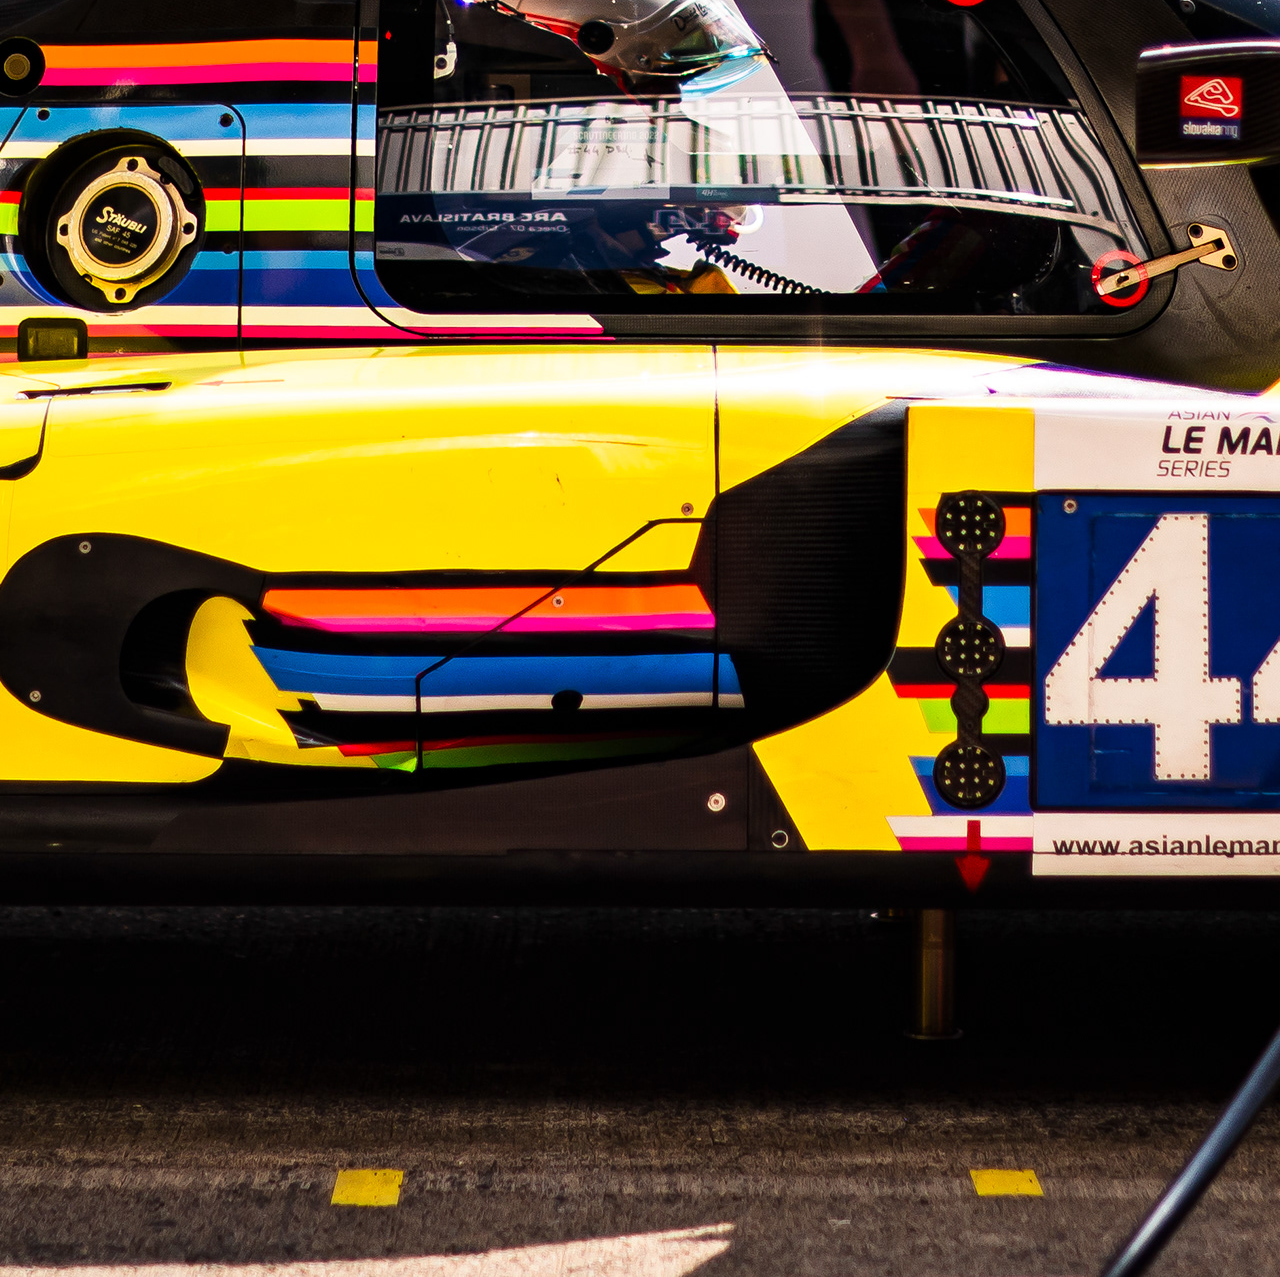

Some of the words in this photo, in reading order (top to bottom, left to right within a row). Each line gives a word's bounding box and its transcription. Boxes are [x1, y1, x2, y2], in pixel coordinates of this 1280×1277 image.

[95, 206, 148, 234] STÄUBLI
[1161, 425, 1206, 454] LE
[1156, 459, 1232, 478] SERIES
